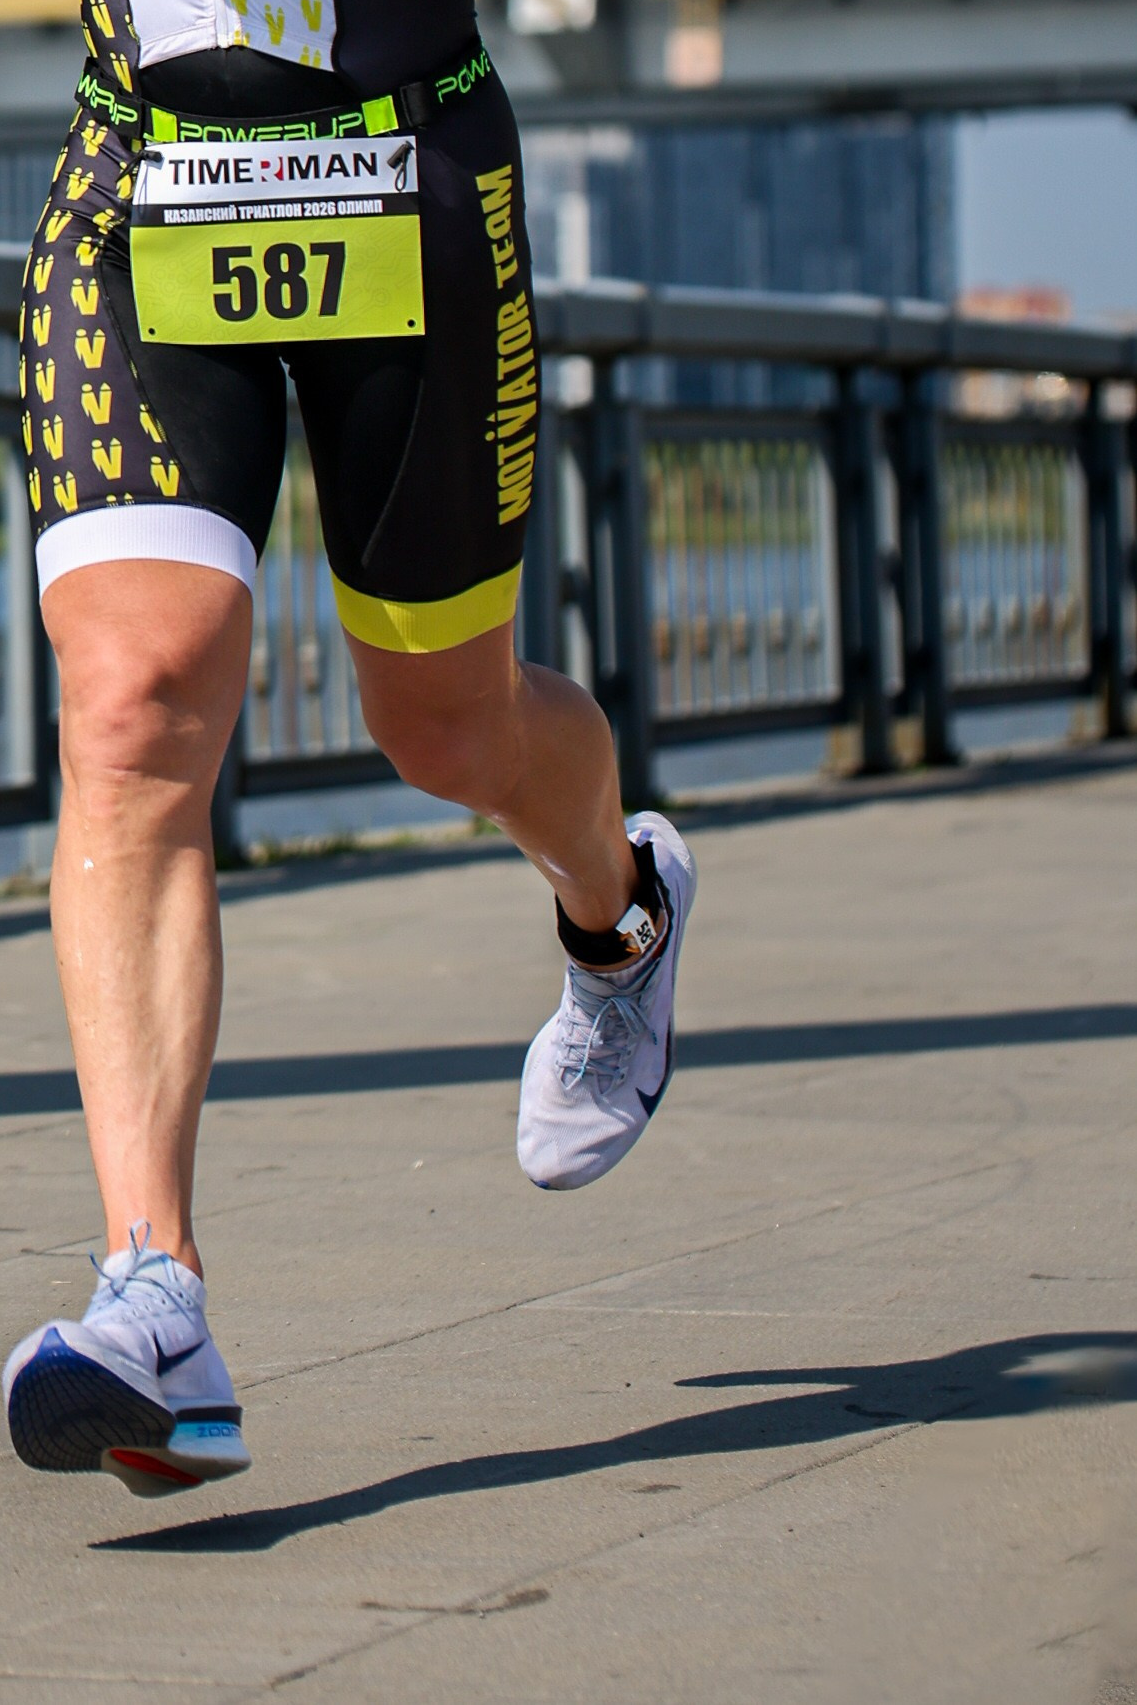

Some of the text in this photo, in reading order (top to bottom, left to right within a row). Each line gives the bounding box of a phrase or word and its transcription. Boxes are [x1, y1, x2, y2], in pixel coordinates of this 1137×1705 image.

[164, 205, 237, 224] КАЗАНСКИЙ
[239, 204, 302, 220] ТРИАТЛОН
[337, 199, 383, 215] ОЛИМП
[211, 241, 347, 322] 587
[475, 164, 537, 525] MOTIVATOR TEAM
